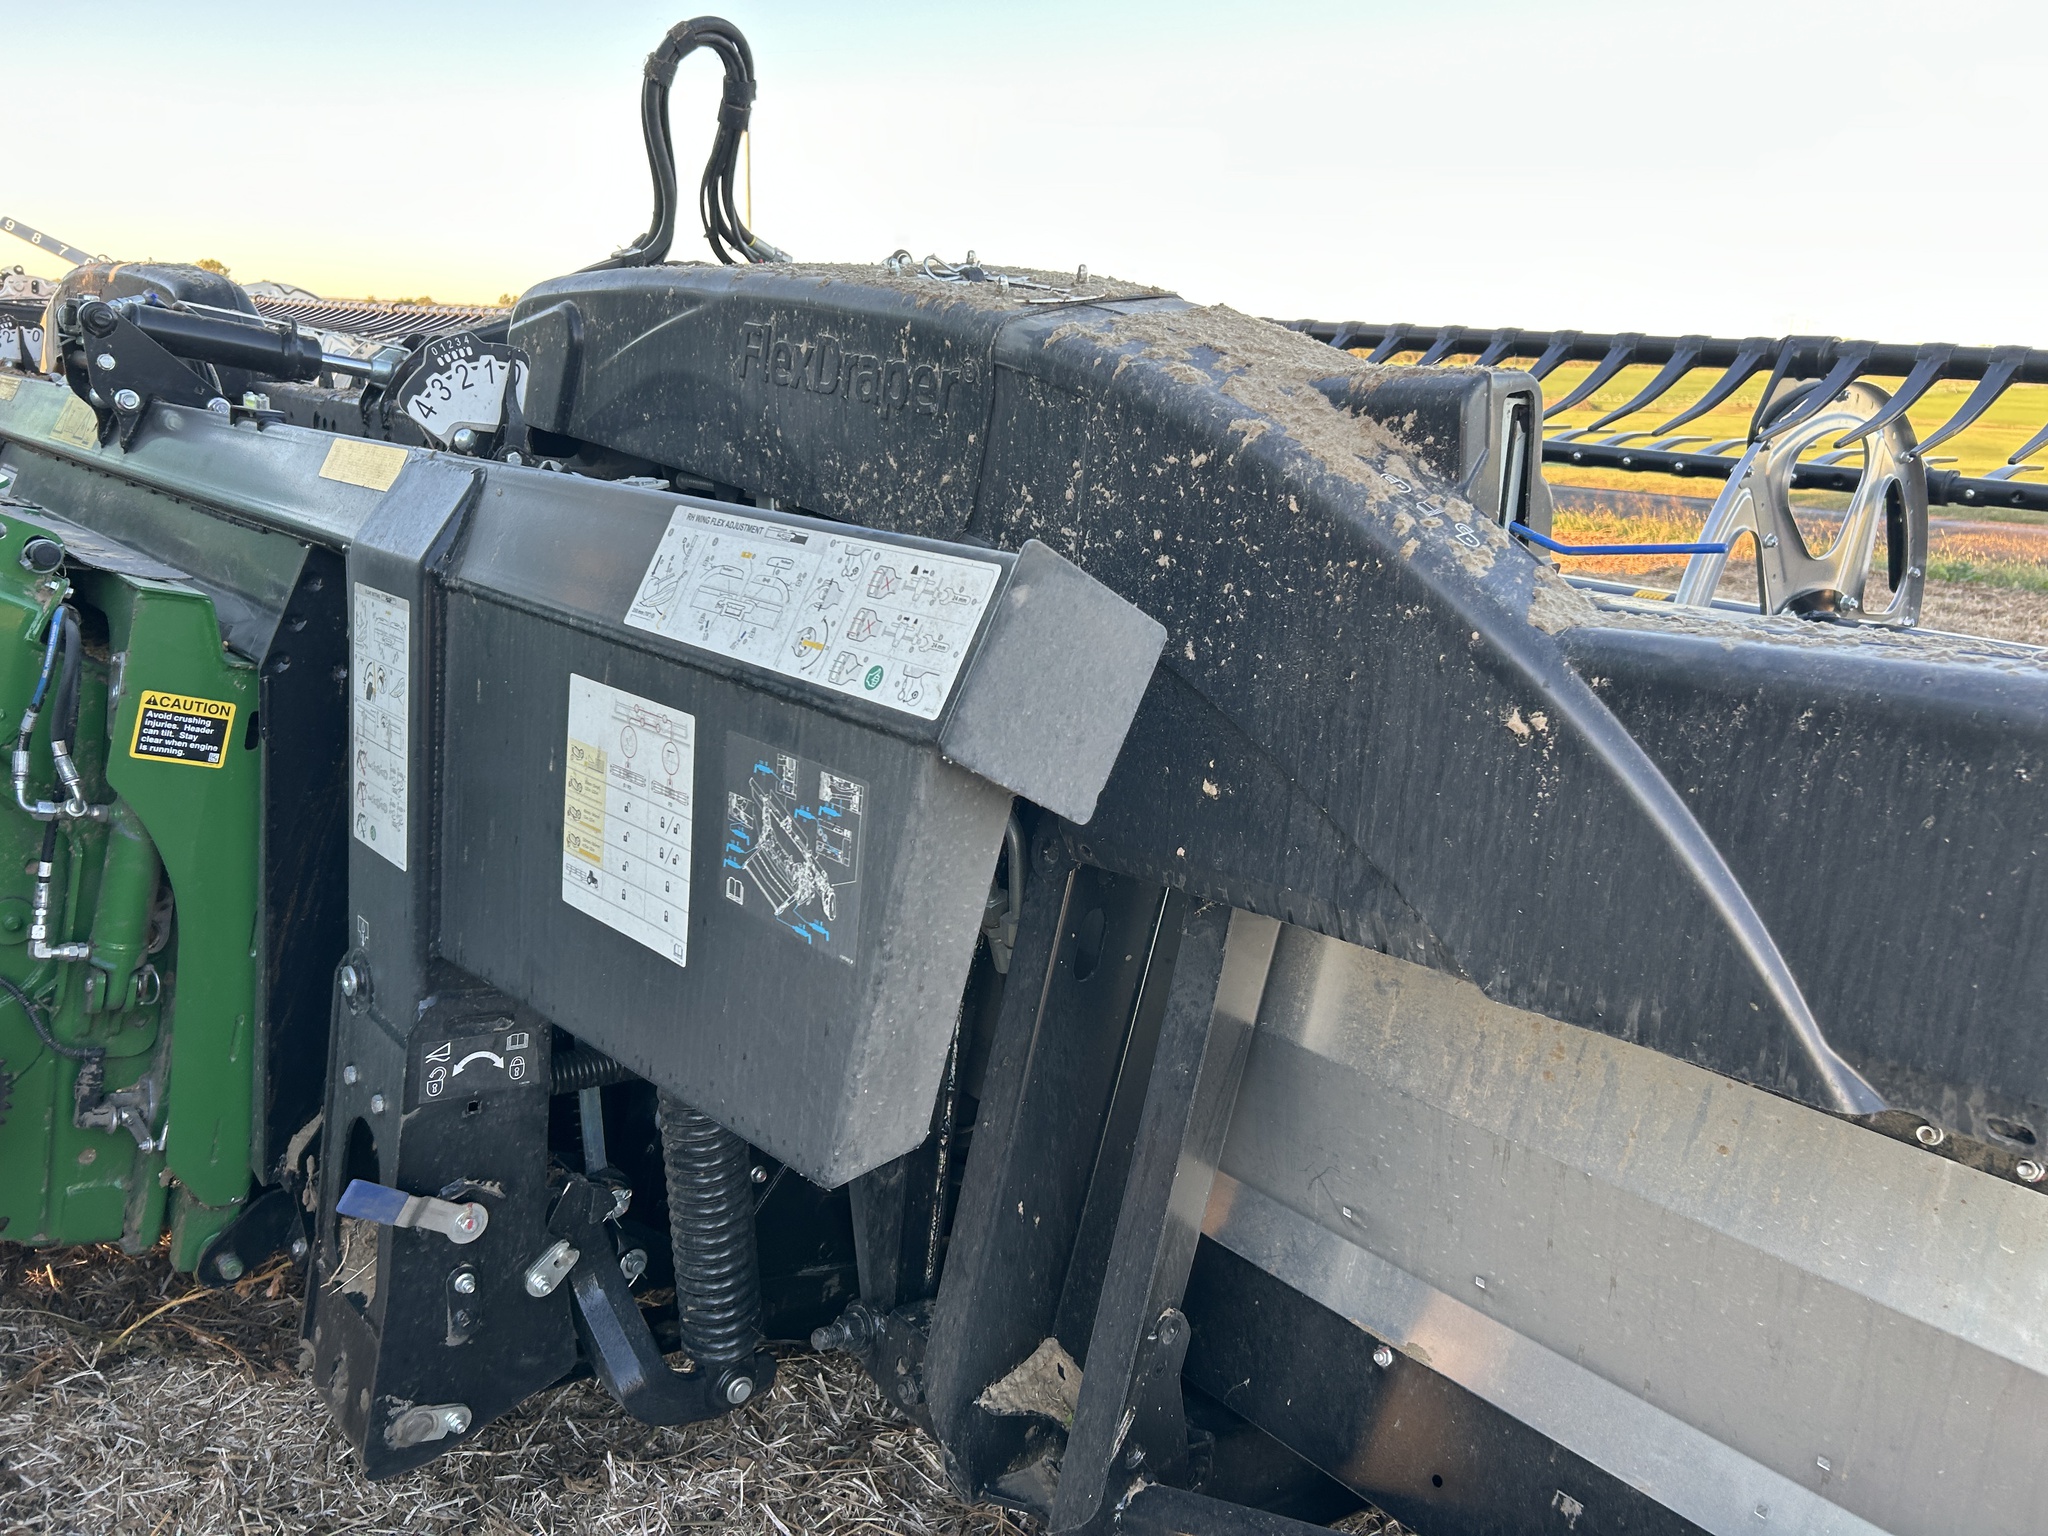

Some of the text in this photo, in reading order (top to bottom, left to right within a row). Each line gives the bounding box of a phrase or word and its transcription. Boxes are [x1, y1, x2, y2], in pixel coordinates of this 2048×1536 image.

[4, 220, 69, 255] 9 8 7
[2, 330, 40, 343] 2 0
[431, 335, 470, 356] 0 1 2 3 4
[415, 399, 437, 419] 4
[431, 378, 452, 401] 3
[455, 364, 474, 390] 2
[484, 359, 494, 384] 1
[686, 512, 764, 535] RH WING FLEX ADJUSTMENT
[159, 696, 231, 716] CAUTION
[144, 718, 215, 735] injuries. Header
[146, 710, 212, 727] Avoid crushing
[140, 735, 218, 752] clear when engine
[142, 728, 199, 742] can tilt. Stay
[139, 743, 185, 757] is running.
